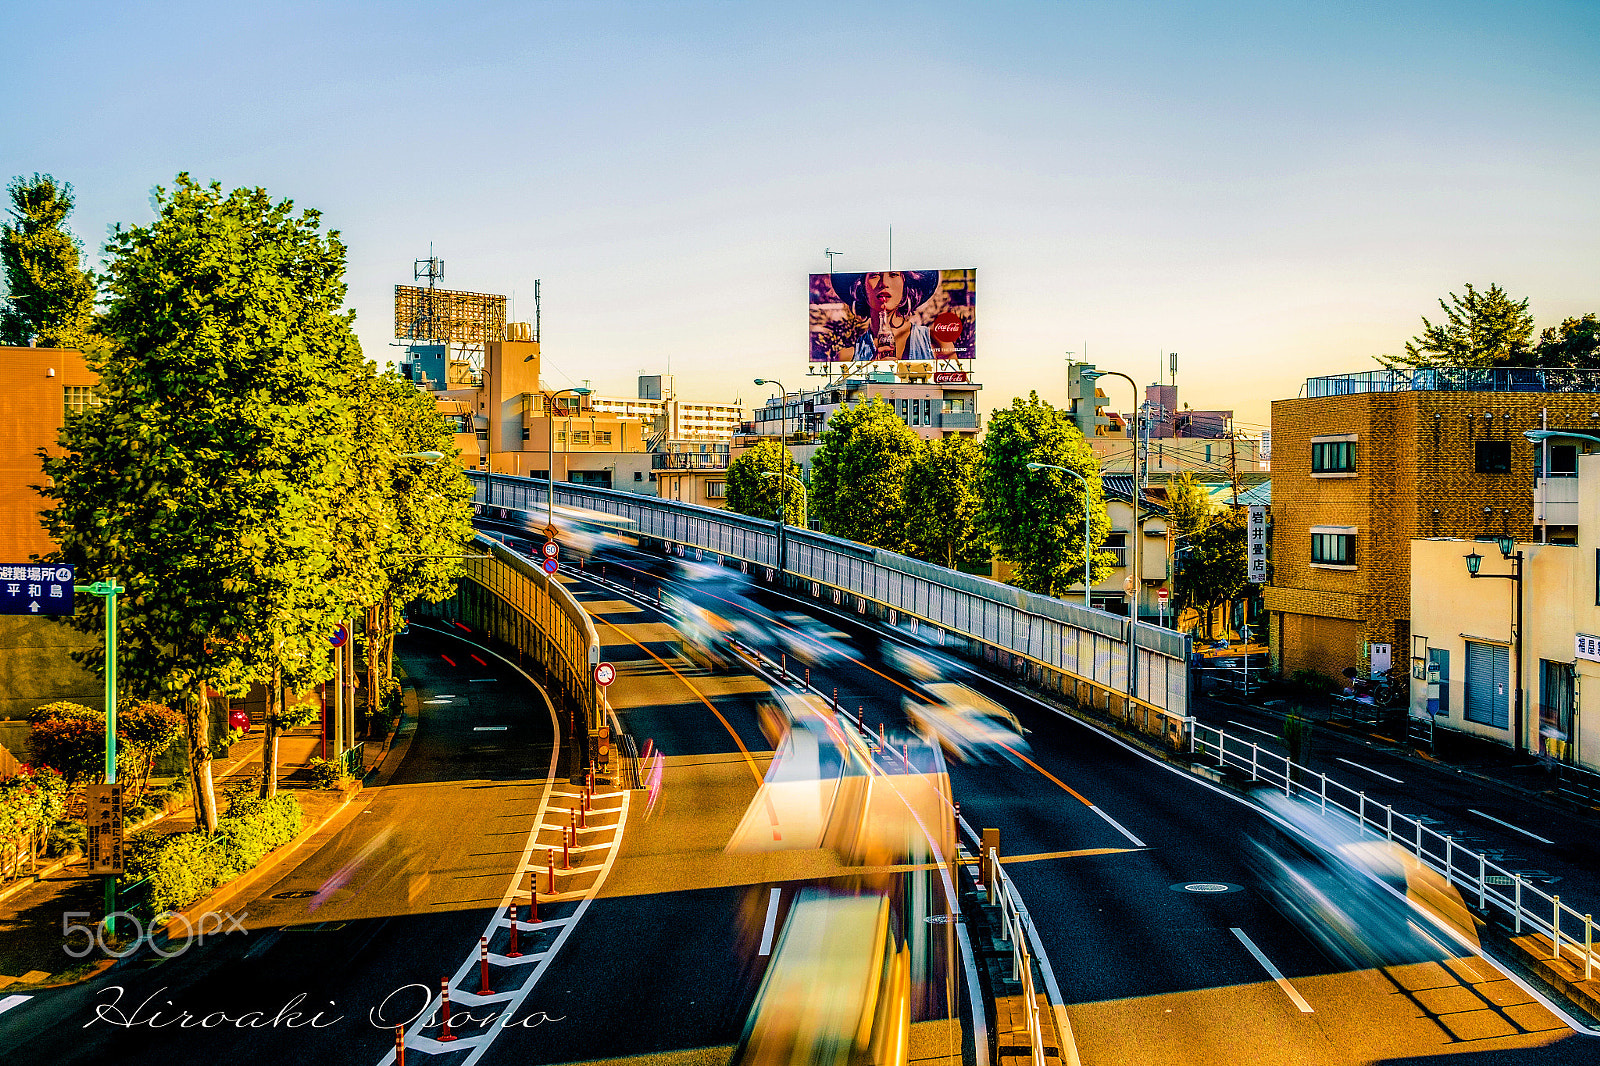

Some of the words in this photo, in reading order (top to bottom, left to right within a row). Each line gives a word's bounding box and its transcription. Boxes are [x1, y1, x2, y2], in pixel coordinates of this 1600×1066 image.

[936, 373, 963, 383] Coca-Cola
[1252, 511, 1264, 571] 岩井畳店
[546, 545, 556, 553] 50
[7, 584, 62, 598] 平和島
